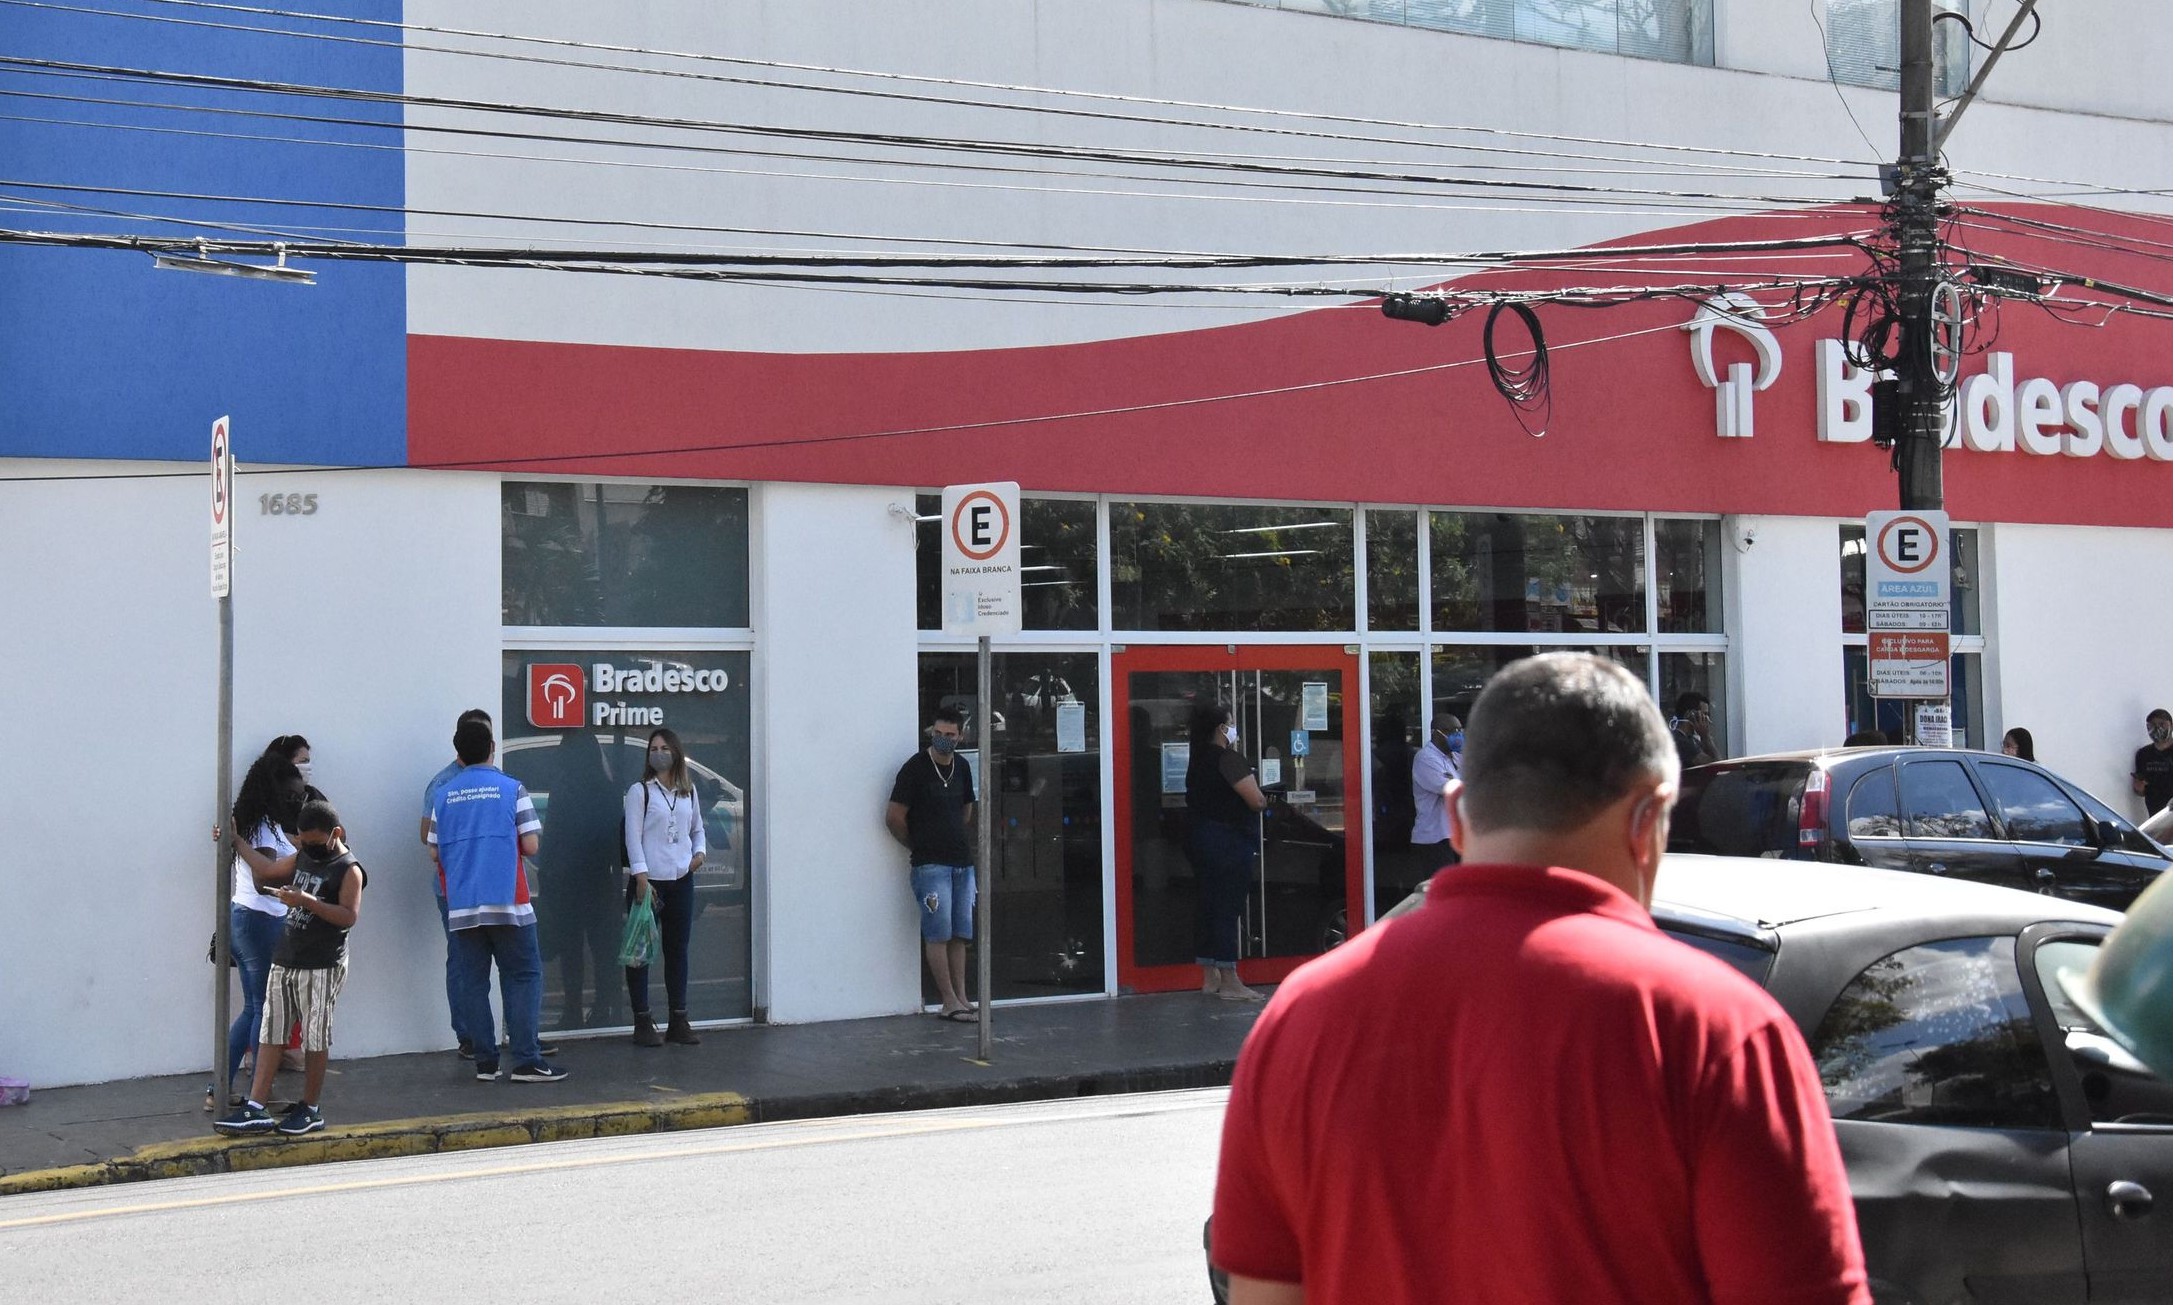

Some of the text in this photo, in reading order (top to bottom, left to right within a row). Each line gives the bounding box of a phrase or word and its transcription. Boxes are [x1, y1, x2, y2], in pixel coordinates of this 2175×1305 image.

[1815, 338, 2173, 461] Bdesco
[259, 493, 318, 515] 1685
[971, 506, 991, 545] E
[1898, 529, 1919, 561] E
[961, 566, 981, 575] FAIXA
[982, 565, 1012, 574] BRANCA
[593, 662, 729, 692] Bradesco
[593, 701, 664, 726] Prime
